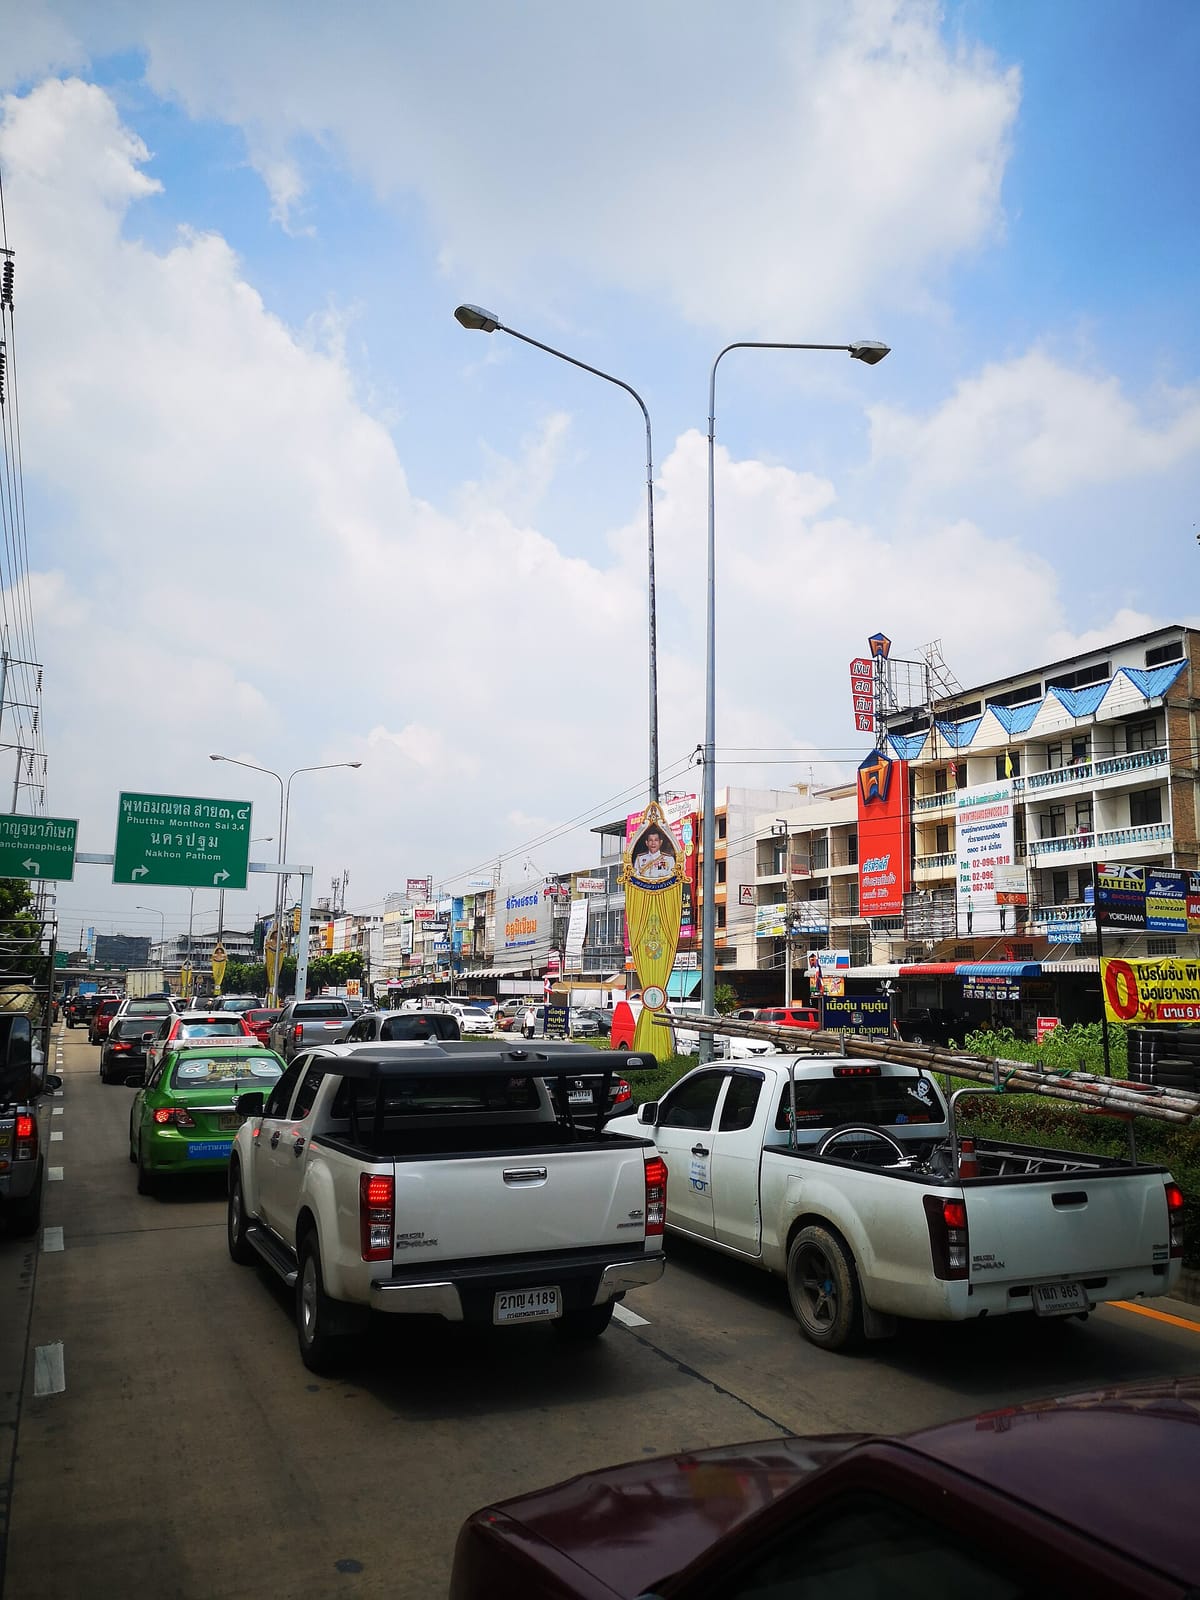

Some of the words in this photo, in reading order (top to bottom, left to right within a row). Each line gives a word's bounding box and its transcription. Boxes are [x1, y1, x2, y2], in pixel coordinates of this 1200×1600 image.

[127, 816, 165, 825] Phuttha
[169, 819, 210, 828] Monthon
[215, 822, 230, 830] Sai
[0, 821, 75, 839] าญจนาภิเษก
[0, 842, 73, 852] anchanaphisek
[145, 849, 181, 858] Nakhon
[186, 852, 221, 861] Pathom
[960, 861, 971, 869] Tel:
[1111, 893, 1144, 901] BOSCH
[1109, 912, 1144, 922] YOKOHAMA
[1164, 1007, 1185, 1018] นาน
[1186, 1006, 1193, 1018] 6
[689, 1177, 709, 1192] TOT
[1060, 1285, 1079, 1298] 965
[527, 1291, 556, 1307] 4189
